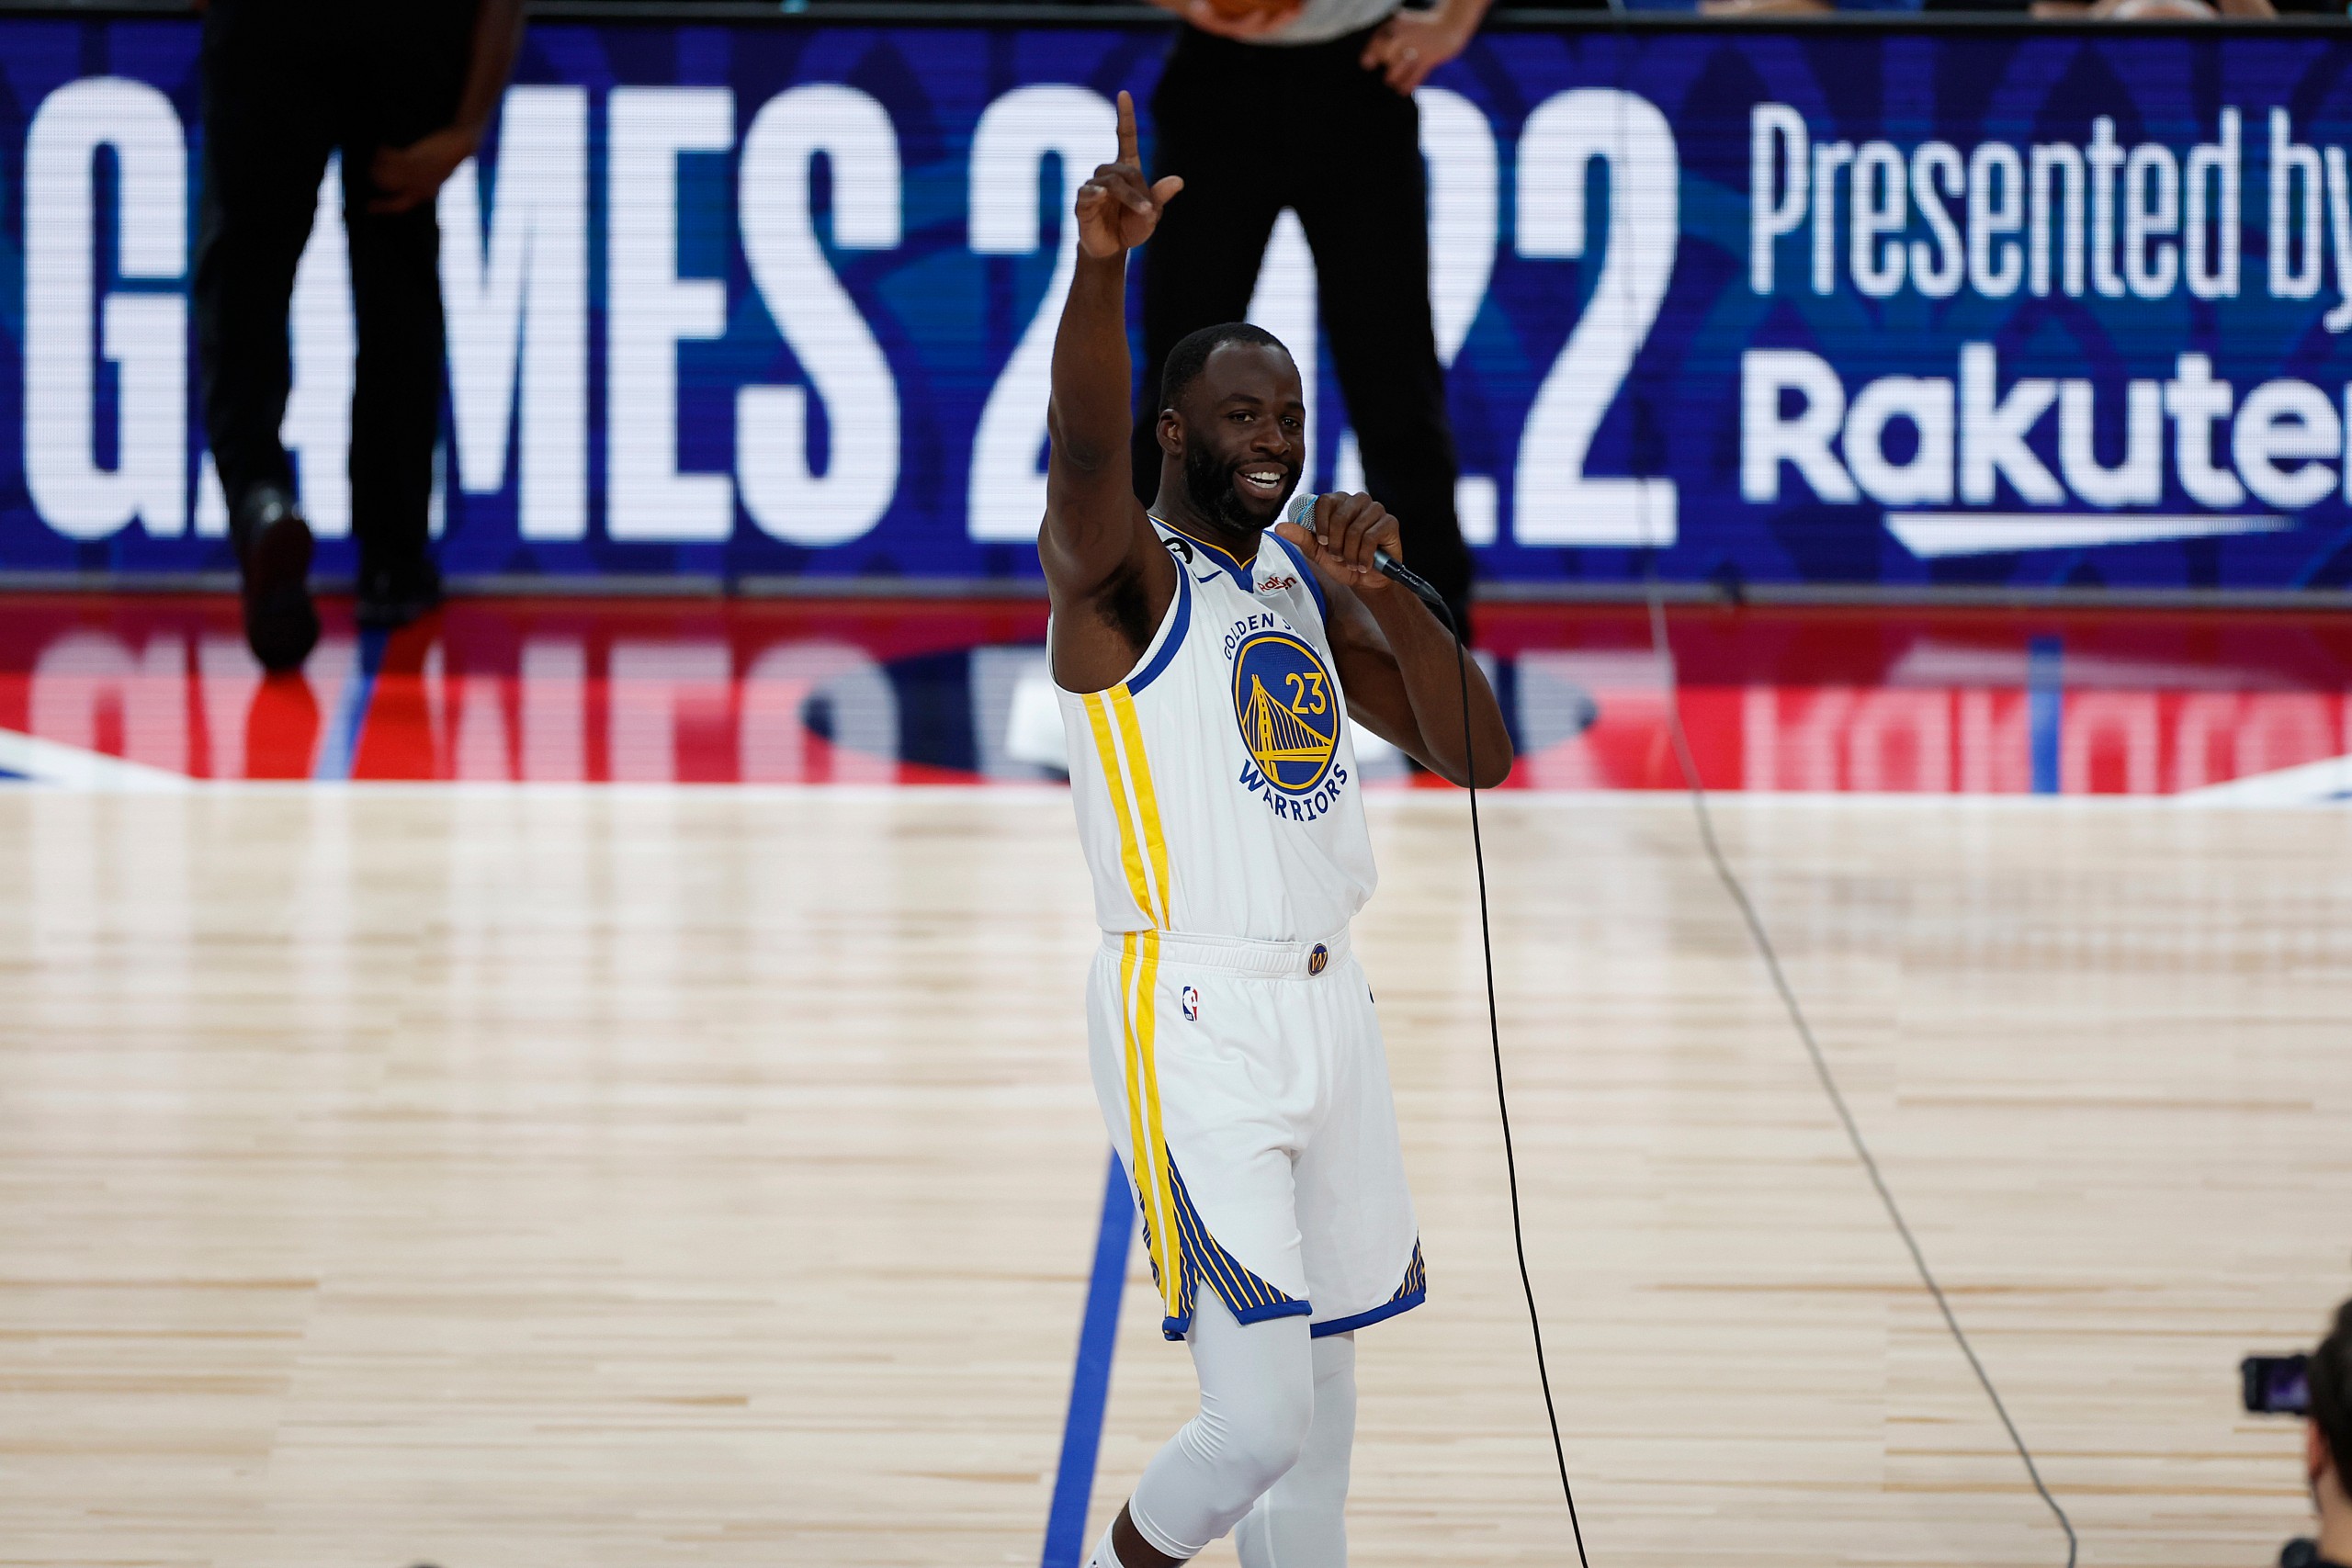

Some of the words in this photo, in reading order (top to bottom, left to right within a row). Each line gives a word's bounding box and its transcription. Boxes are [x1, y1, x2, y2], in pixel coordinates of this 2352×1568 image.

[1749, 103, 2241, 299] Presented
[1741, 343, 2352, 507] Rakute
[1224, 613, 1274, 660] GOLDEN
[1286, 672, 1327, 715] 23
[1238, 759, 1348, 822] WARRIORS
